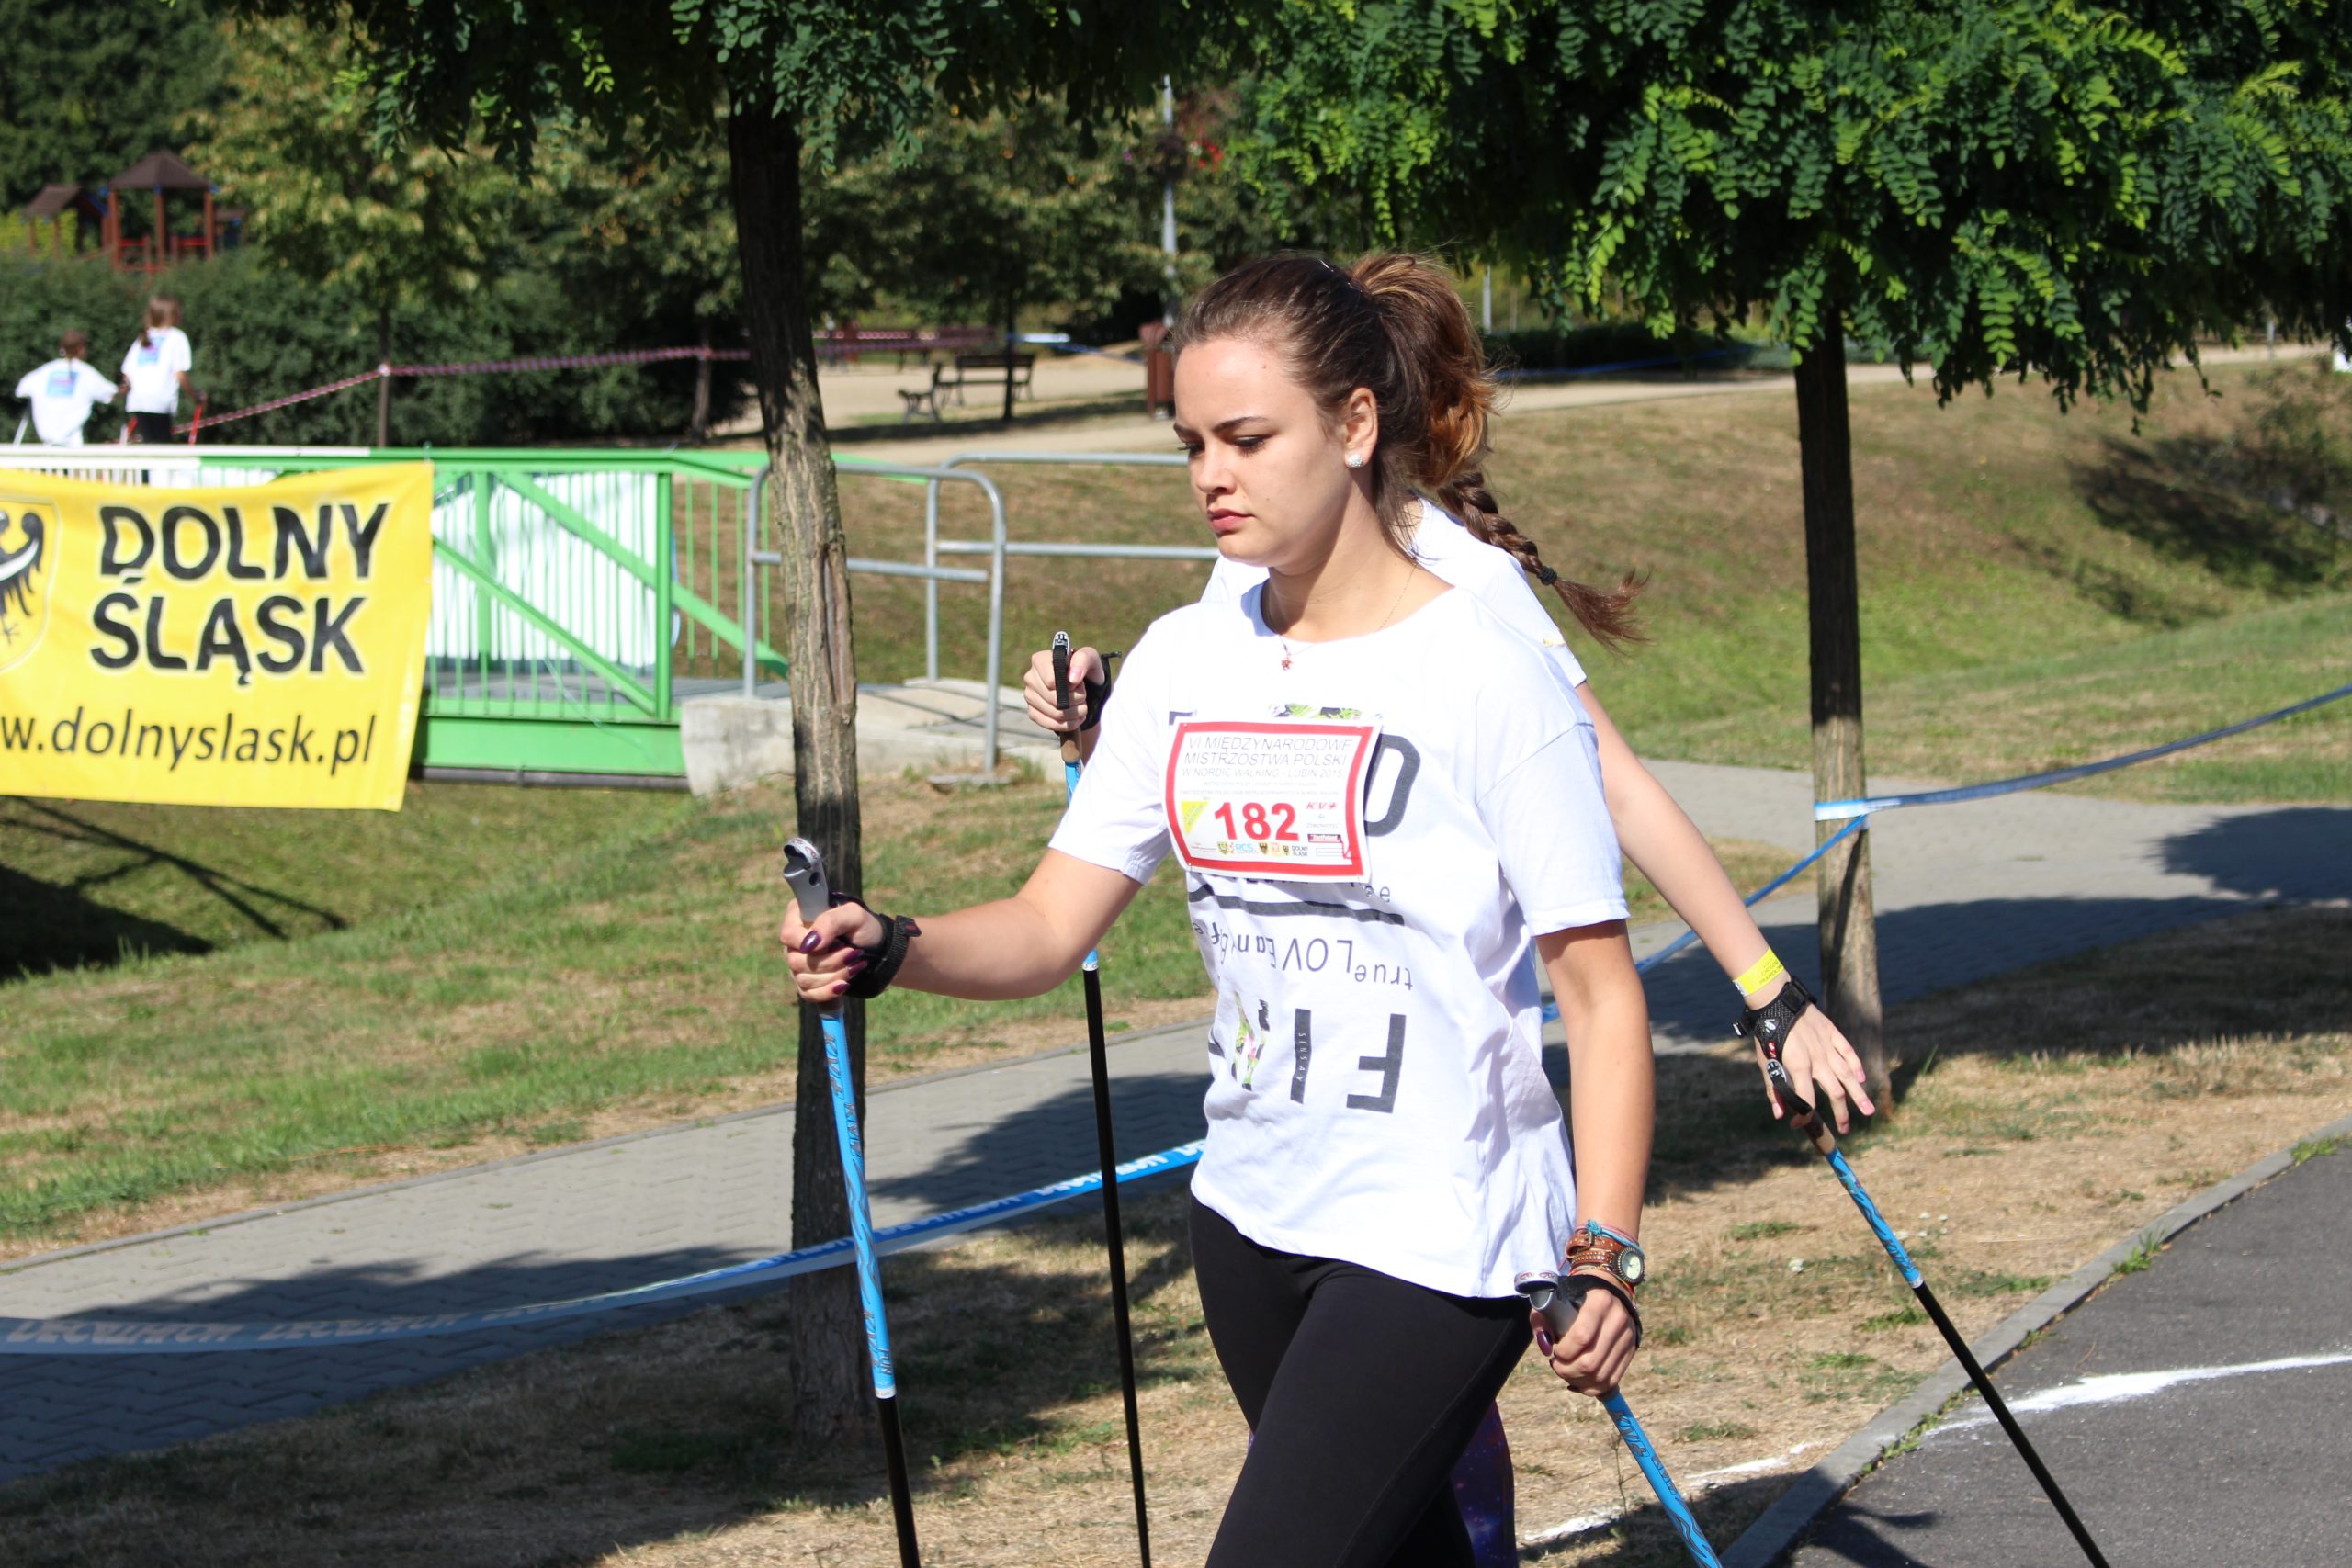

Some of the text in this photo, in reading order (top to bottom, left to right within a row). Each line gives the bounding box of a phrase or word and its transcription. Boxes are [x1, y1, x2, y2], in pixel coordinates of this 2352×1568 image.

[98, 502, 390, 581] DOLNY
[90, 577, 368, 686] ŚLĄSK
[0, 705, 375, 776] w.dolnyslask.pl
[1184, 751, 1348, 766] MISTRZOSTWA POLSKI
[1189, 736, 1353, 753] VI MIĘDZYNARODOWE
[1193, 767, 1231, 778] NORDIC
[1234, 768, 1280, 778] WALKING
[1287, 769, 1317, 779] LUBIN
[1214, 801, 1299, 842] 182
[1295, 1032, 1308, 1082] SINSAY
